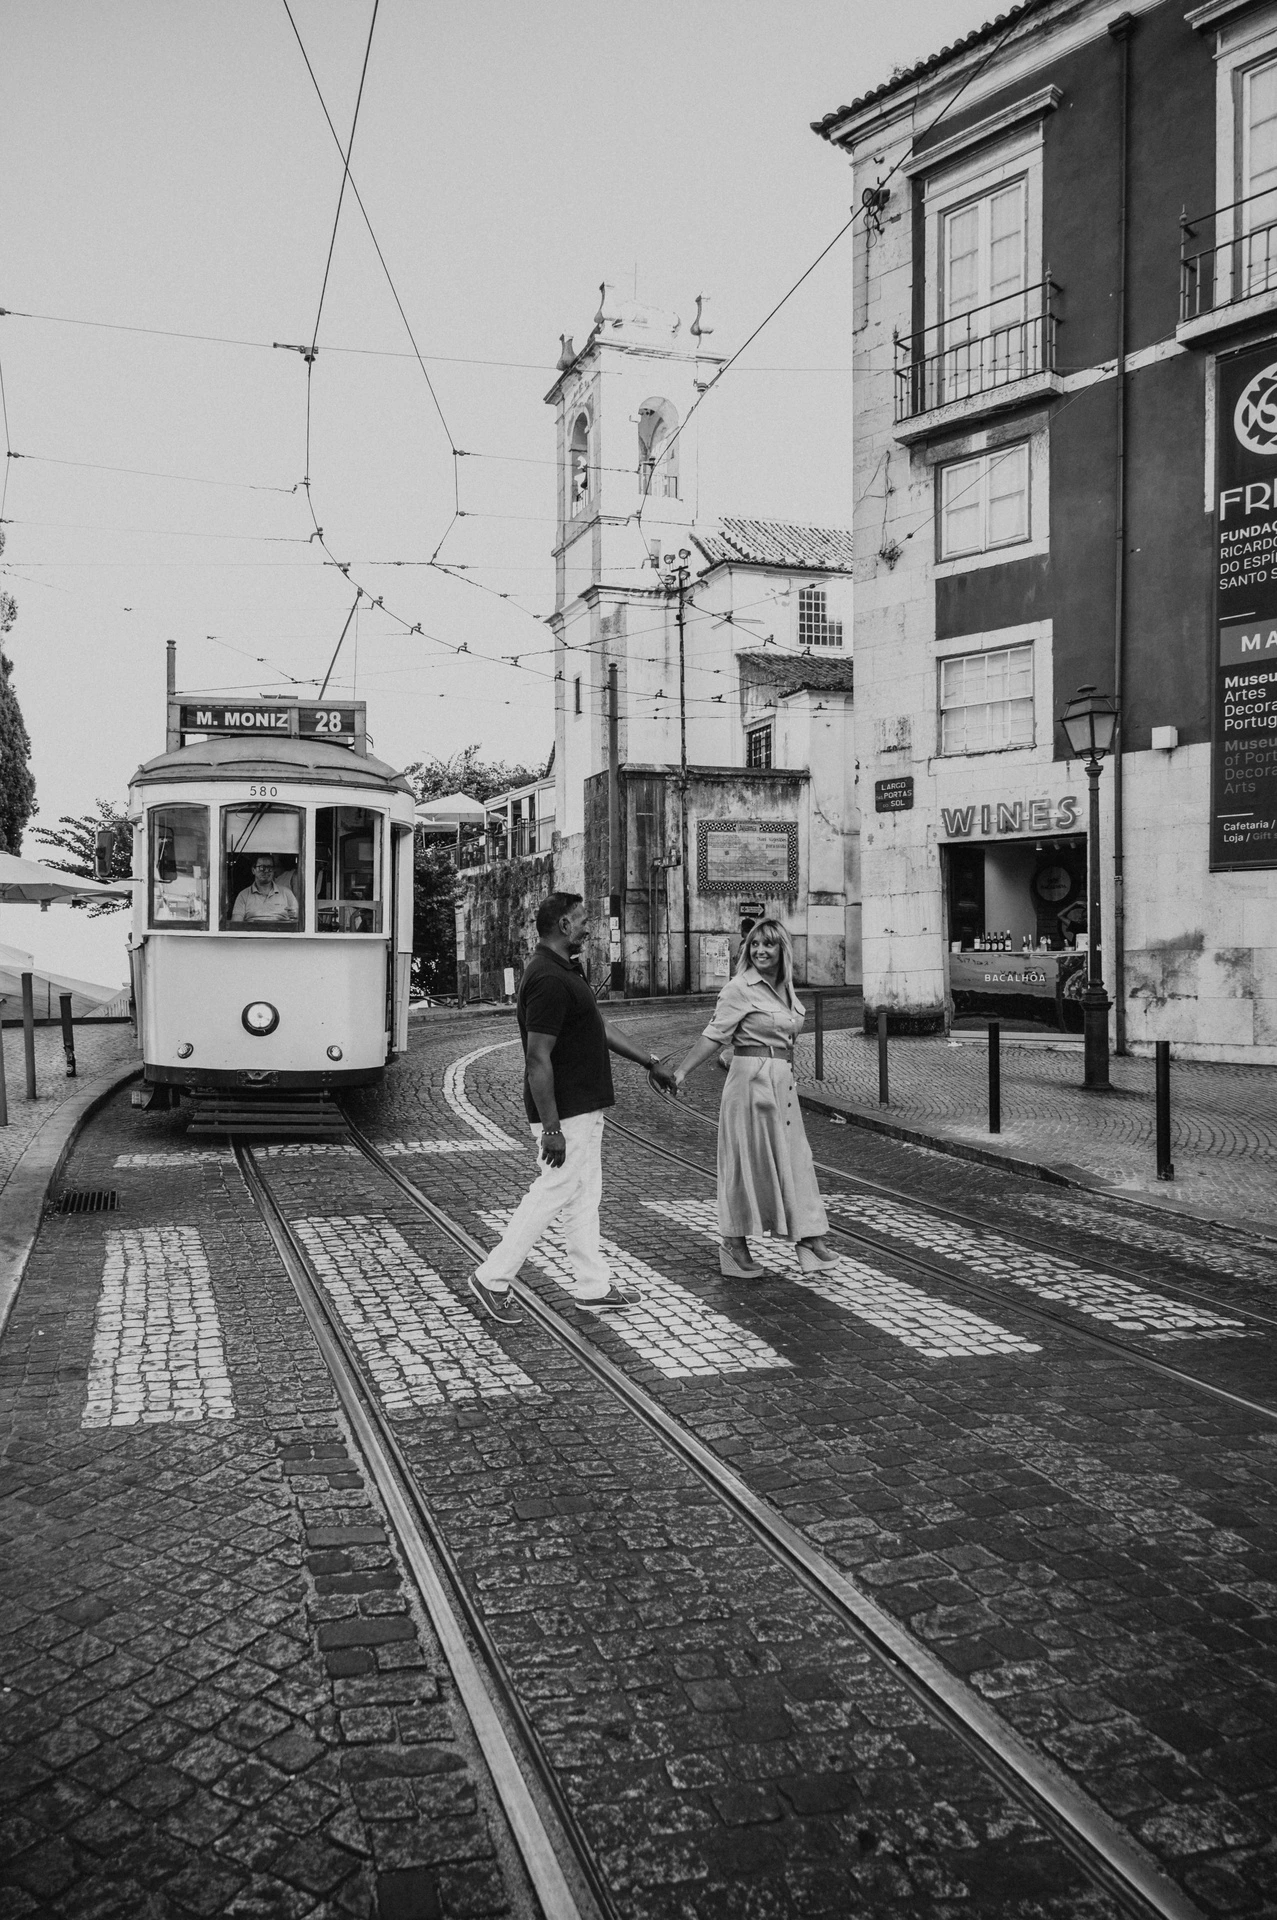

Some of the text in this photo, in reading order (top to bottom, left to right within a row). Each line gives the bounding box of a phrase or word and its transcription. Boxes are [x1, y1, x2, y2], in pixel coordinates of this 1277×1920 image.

[1220, 477, 1277, 521] FR
[1220, 550, 1277, 575] DO ESPÍ
[1219, 570, 1267, 590] SANTO
[1224, 672, 1277, 689] Museu
[1224, 688, 1266, 703] Artes
[196, 711, 289, 728] M. MONIZ
[315, 711, 342, 732] 28
[1224, 715, 1277, 731] Portug
[1224, 753, 1240, 766] of
[250, 785, 278, 797] 580
[881, 782, 906, 791] LARGO
[1224, 782, 1256, 794] Arts
[883, 790, 912, 799] PORTAS
[940, 795, 1077, 837] WINES
[1223, 821, 1269, 831] Cafetaria
[1223, 833, 1244, 843] Loja
[1252, 832, 1271, 840] Gift
[984, 971, 1046, 982] BACALHÔA
